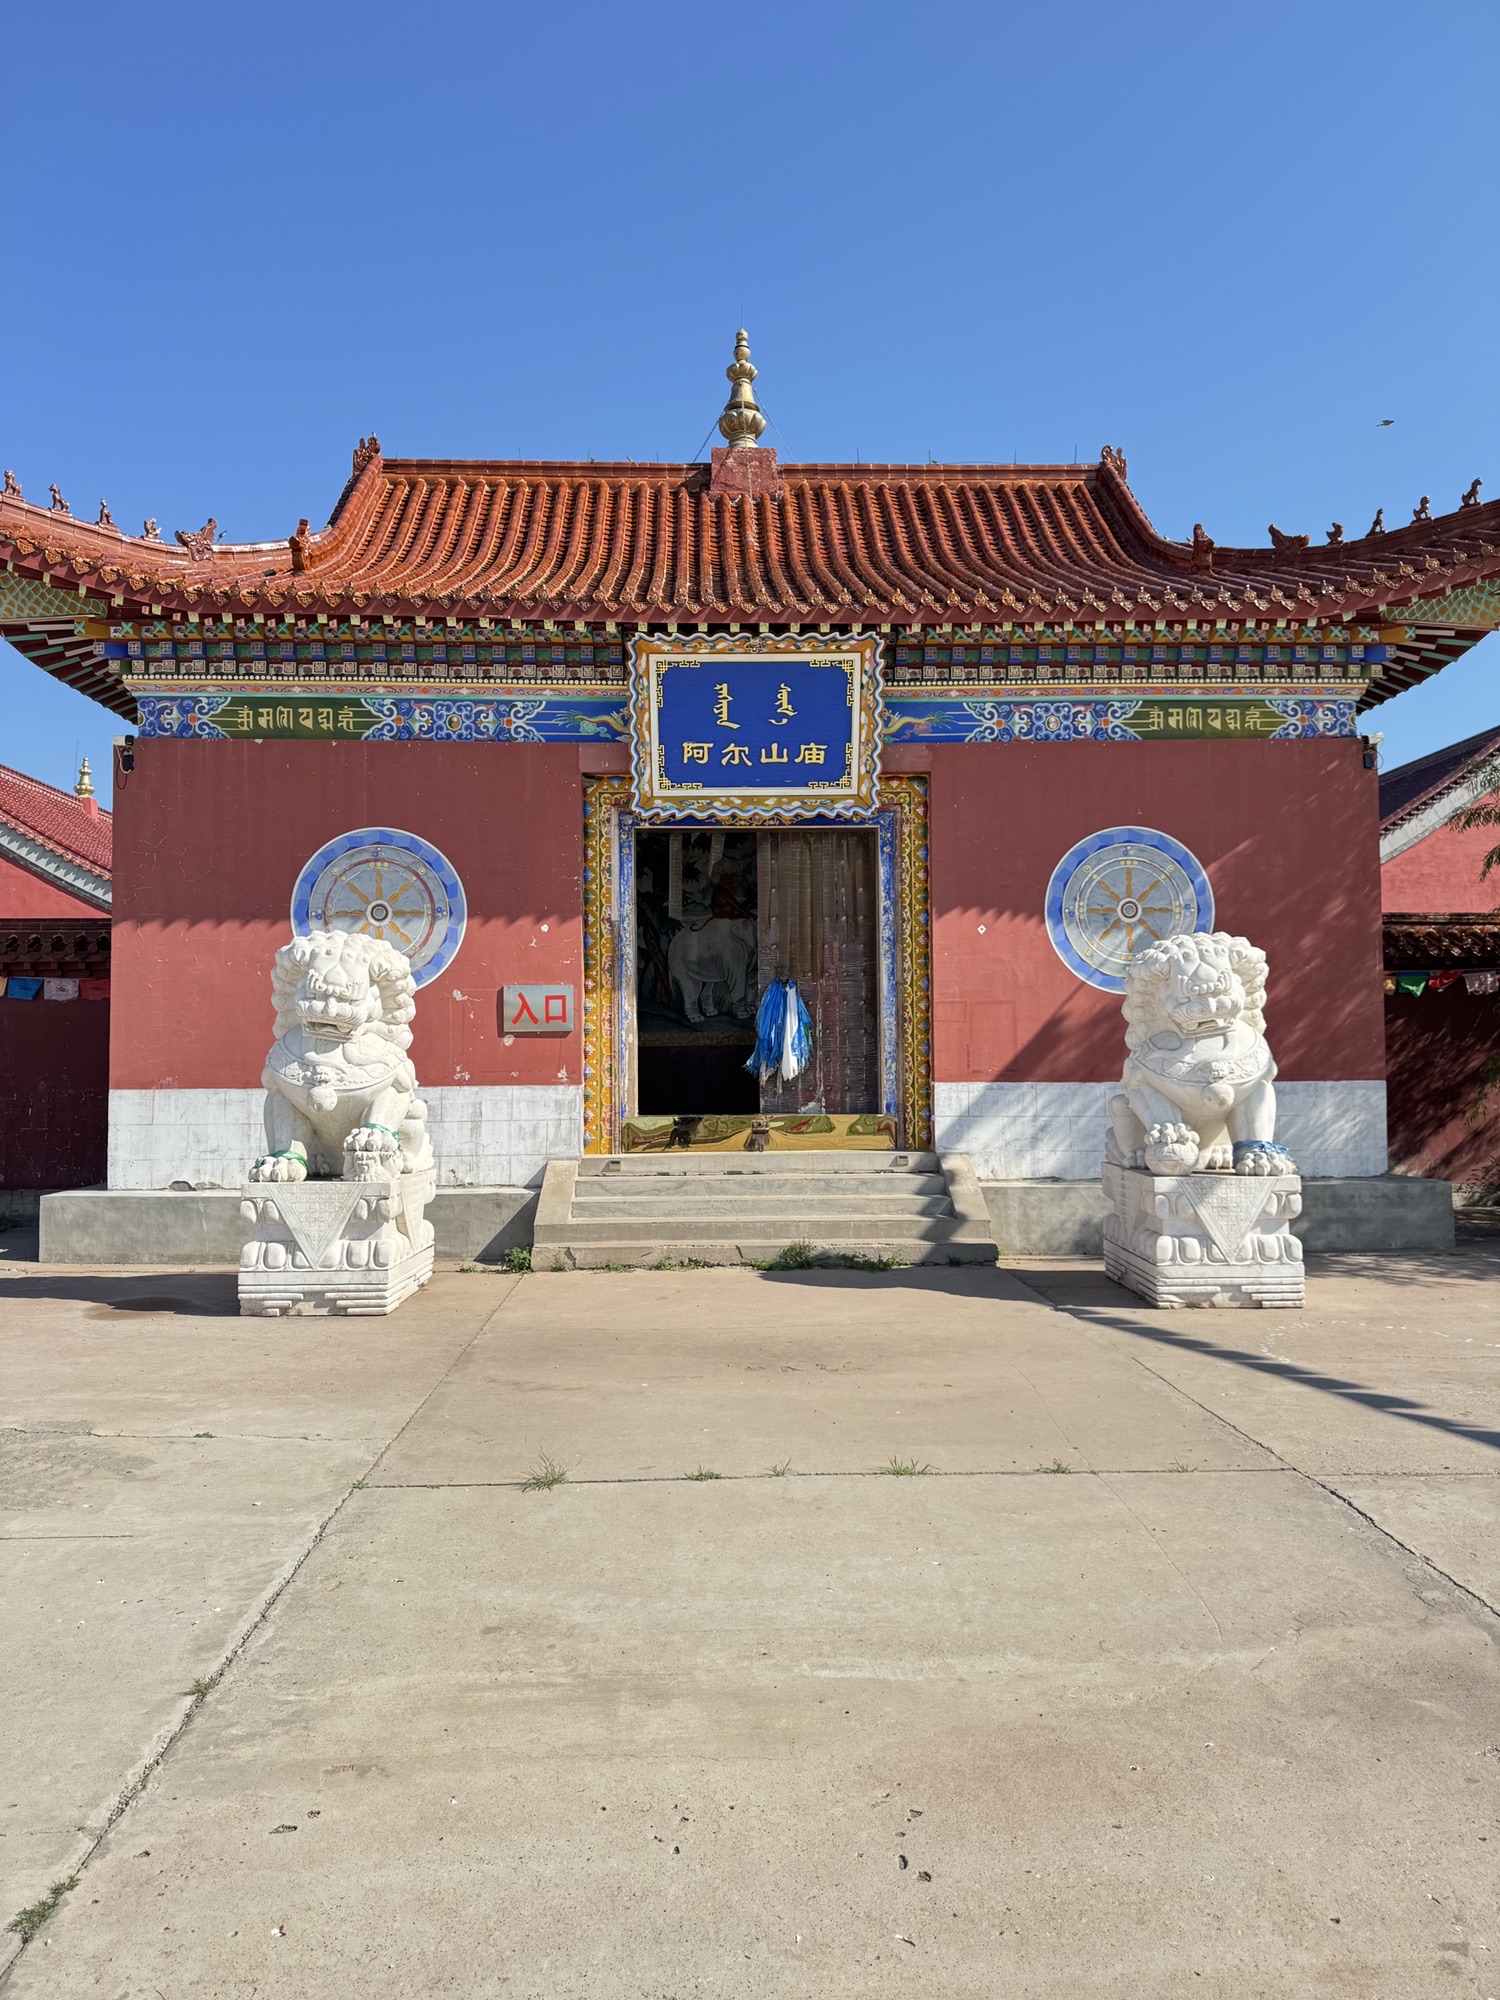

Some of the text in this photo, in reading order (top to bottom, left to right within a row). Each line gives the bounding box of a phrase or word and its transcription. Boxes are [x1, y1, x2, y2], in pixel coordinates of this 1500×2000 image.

[683, 742, 827, 766] 阿尔山庙
[512, 993, 567, 1024] 入口
